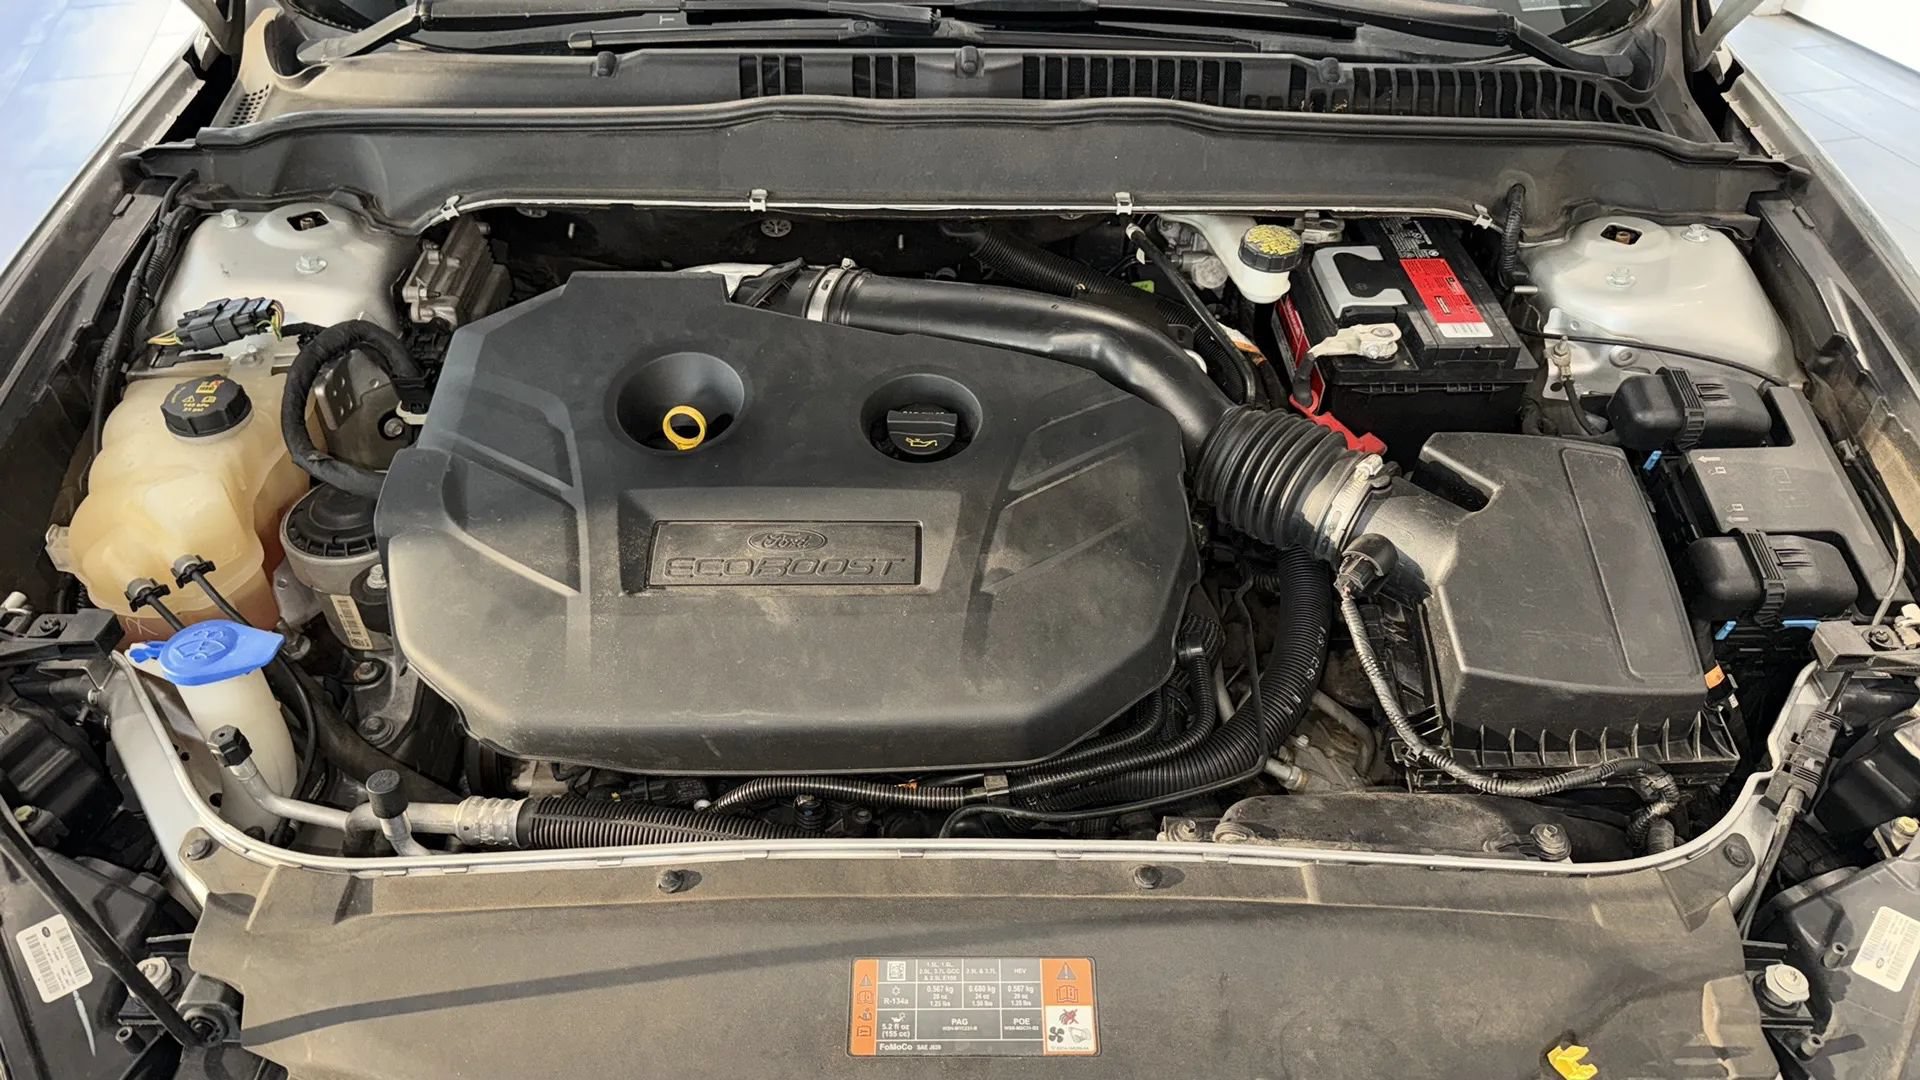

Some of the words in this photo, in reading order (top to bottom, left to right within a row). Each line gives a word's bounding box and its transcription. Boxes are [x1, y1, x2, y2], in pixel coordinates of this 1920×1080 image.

[763, 531, 811, 549] Ford
[665, 556, 906, 579] ECOBOOST
[945, 985, 954, 994] kg
[987, 985, 996, 994] kg
[1025, 985, 1034, 994] kg
[883, 997, 909, 1005] R-134a
[951, 1018, 969, 1026] PAG
[1013, 1018, 1031, 1026] POE
[881, 1030, 898, 1038] (155
[898, 1030, 911, 1038] cc)
[879, 1043, 913, 1051] FoMoCo
